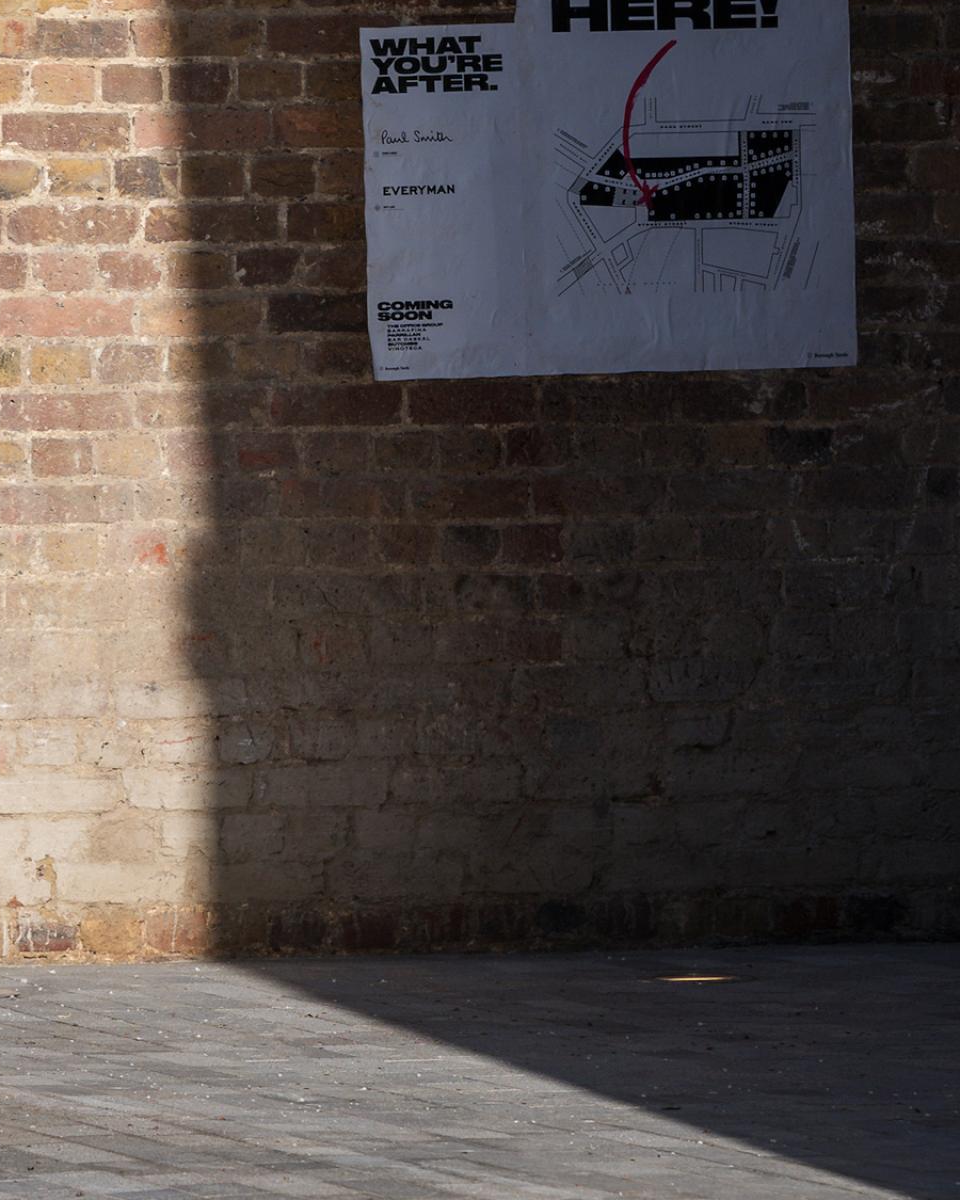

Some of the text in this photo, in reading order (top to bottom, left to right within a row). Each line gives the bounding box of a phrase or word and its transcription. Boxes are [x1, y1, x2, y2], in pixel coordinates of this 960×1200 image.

[369, 36, 482, 57] WHAT
[370, 54, 503, 75] YOU'RE
[371, 74, 498, 94] AFTER.
[381, 129, 453, 144] Paul Smith
[383, 184, 455, 196] EVERYMAN
[377, 300, 453, 311] COMING
[377, 311, 433, 321] SOON
